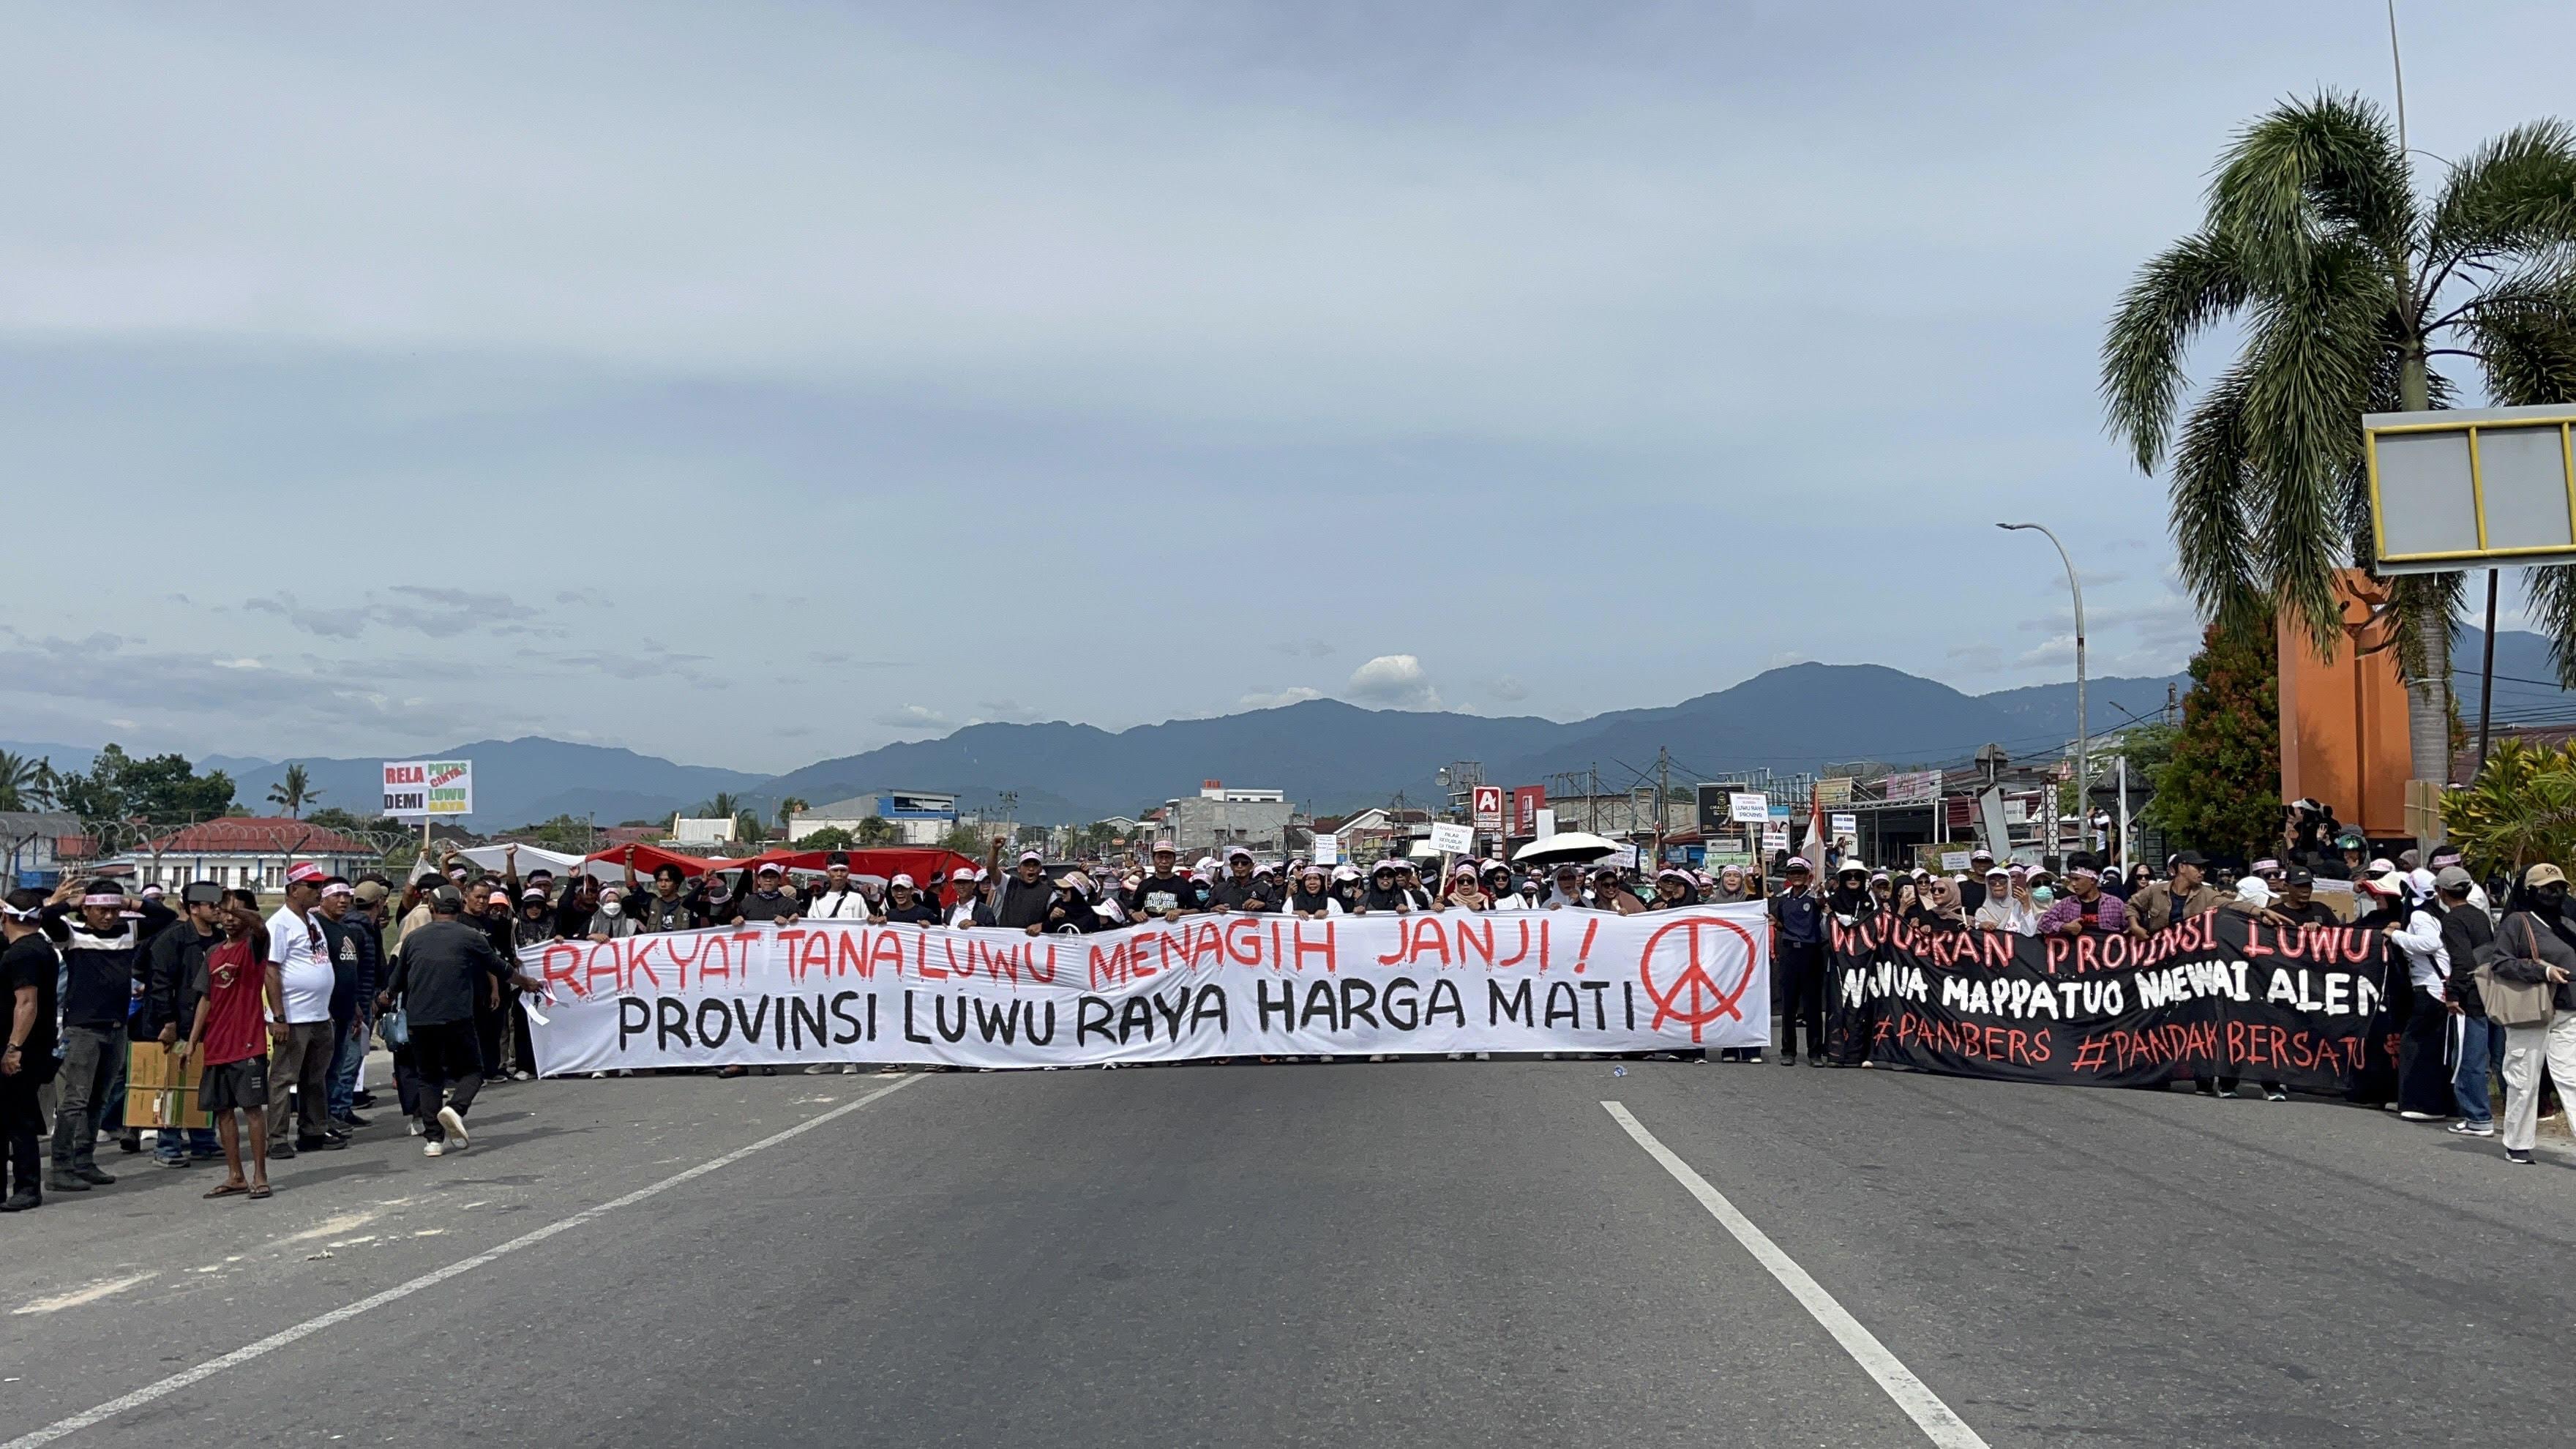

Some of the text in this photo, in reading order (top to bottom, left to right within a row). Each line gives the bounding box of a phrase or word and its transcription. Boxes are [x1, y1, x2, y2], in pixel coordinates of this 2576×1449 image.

[384, 793, 423, 809] DEMI
[386, 767, 424, 784] RELA
[428, 788, 465, 801] LUWU
[542, 917, 1598, 1005] RAKYAT TANA LUWU MENAGIH JANJI !
[2046, 905, 2218, 974] PROVINSI
[2243, 918, 2373, 964] LUWU
[618, 977, 1636, 1051] PROVINSI LUWU RAYA HARGA MATI
[1942, 975, 2124, 1020] MAPPATUO
[2134, 959, 2251, 1010] NAEWAI
[1873, 1011, 2052, 1066] #PANBERS
